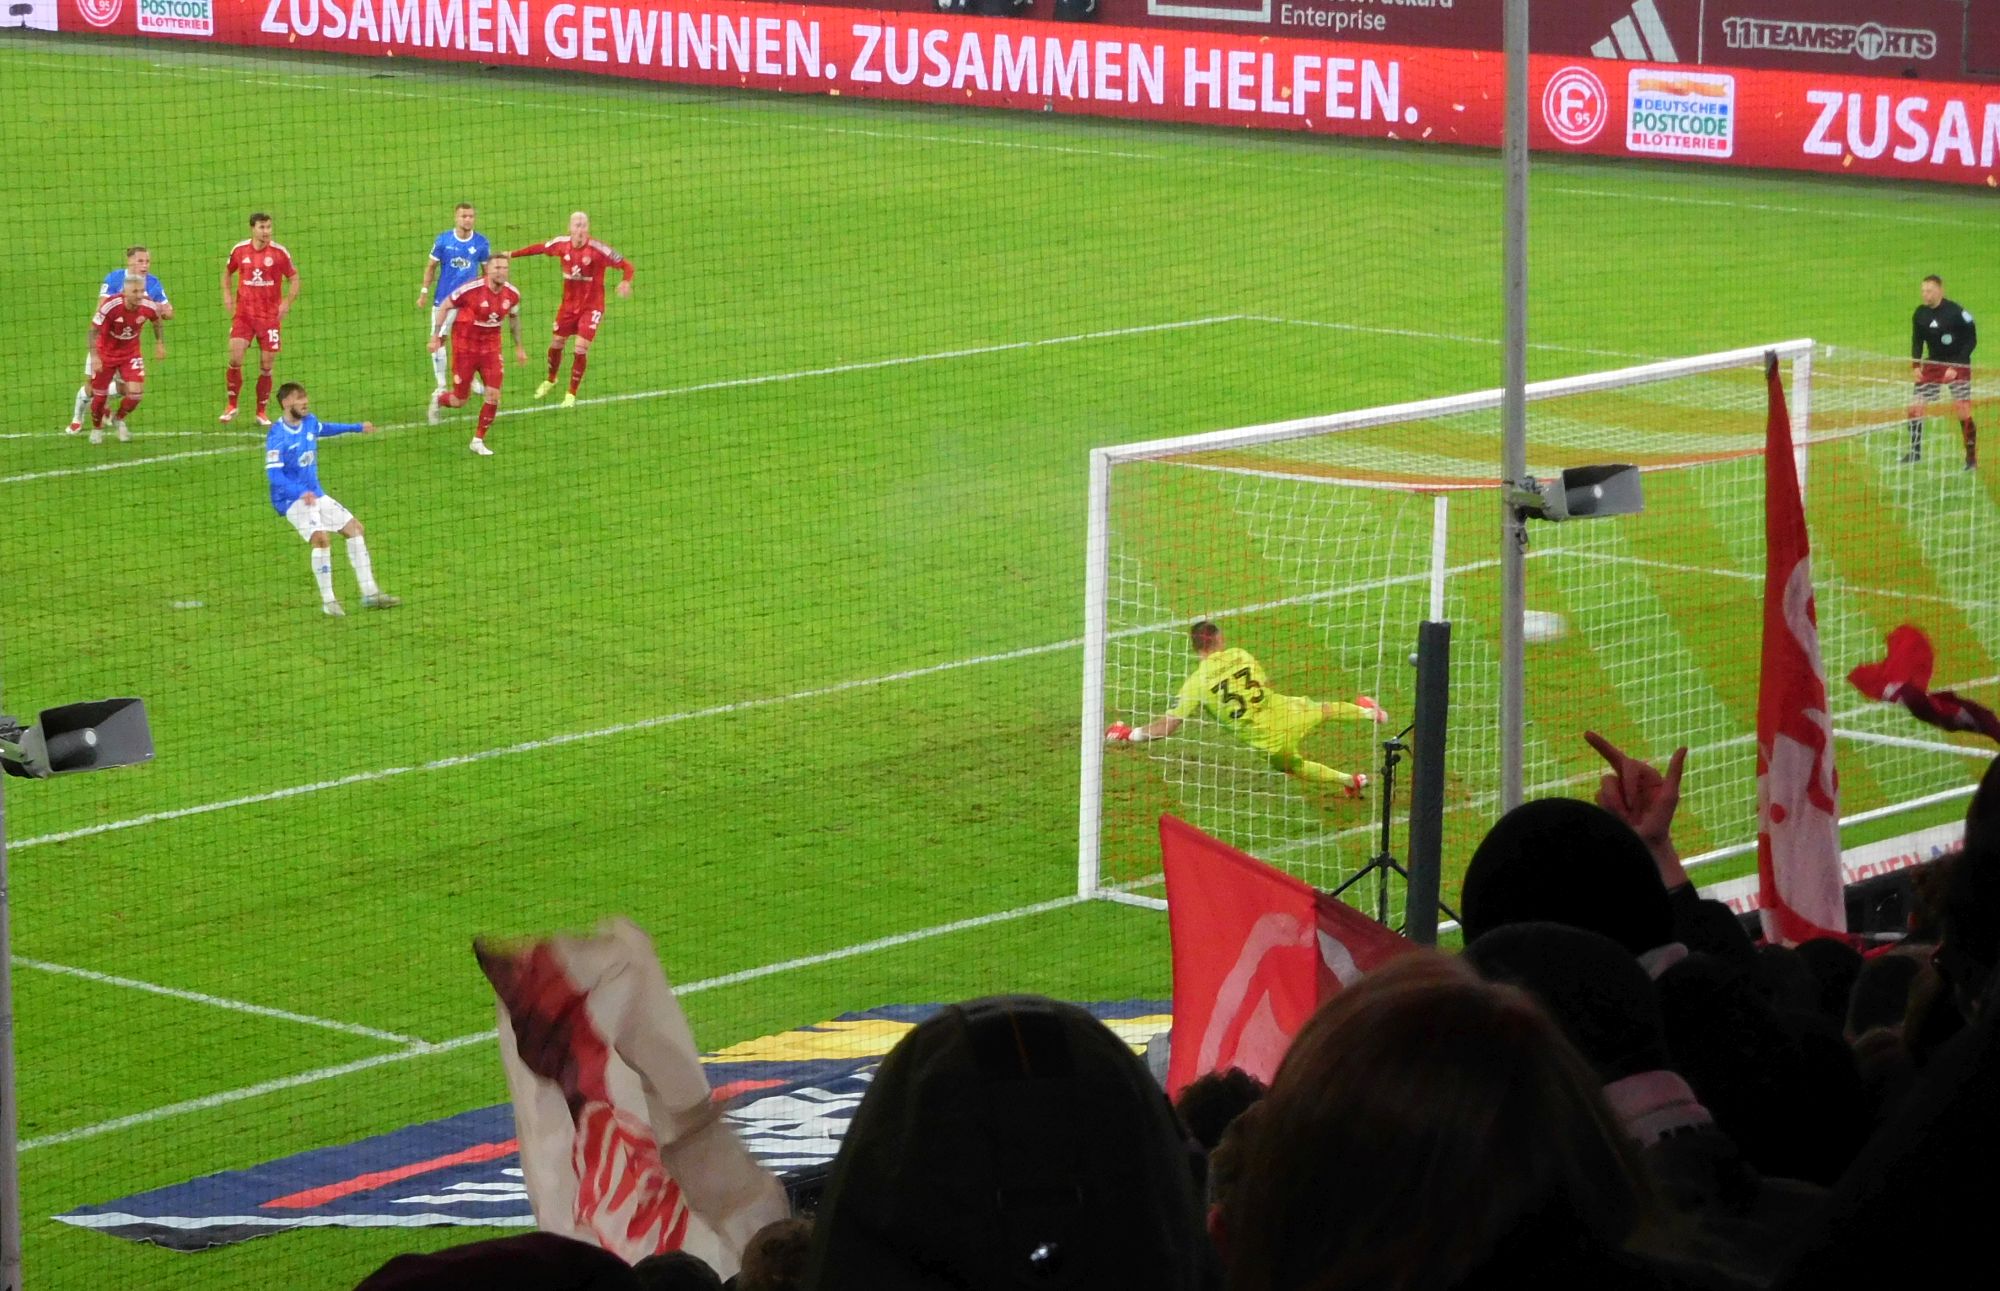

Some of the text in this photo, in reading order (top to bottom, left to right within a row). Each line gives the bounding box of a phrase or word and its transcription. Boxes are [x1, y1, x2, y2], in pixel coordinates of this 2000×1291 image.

[141, 0, 208, 18] POSTCODE
[1280, 4, 1386, 32] Enterprise
[149, 17, 200, 30] LOTTERIE
[260, 0, 1418, 125] ZUSAMMEN GEWINNEN. ZUSAMMEN HELFEN.
[1644, 98, 1717, 115] DEUTSCHE
[1632, 111, 1727, 137] POSTCODE
[1643, 133, 1716, 150] LOTTERIE
[267, 329, 279, 342] 15
[1211, 666, 1265, 719] 33
